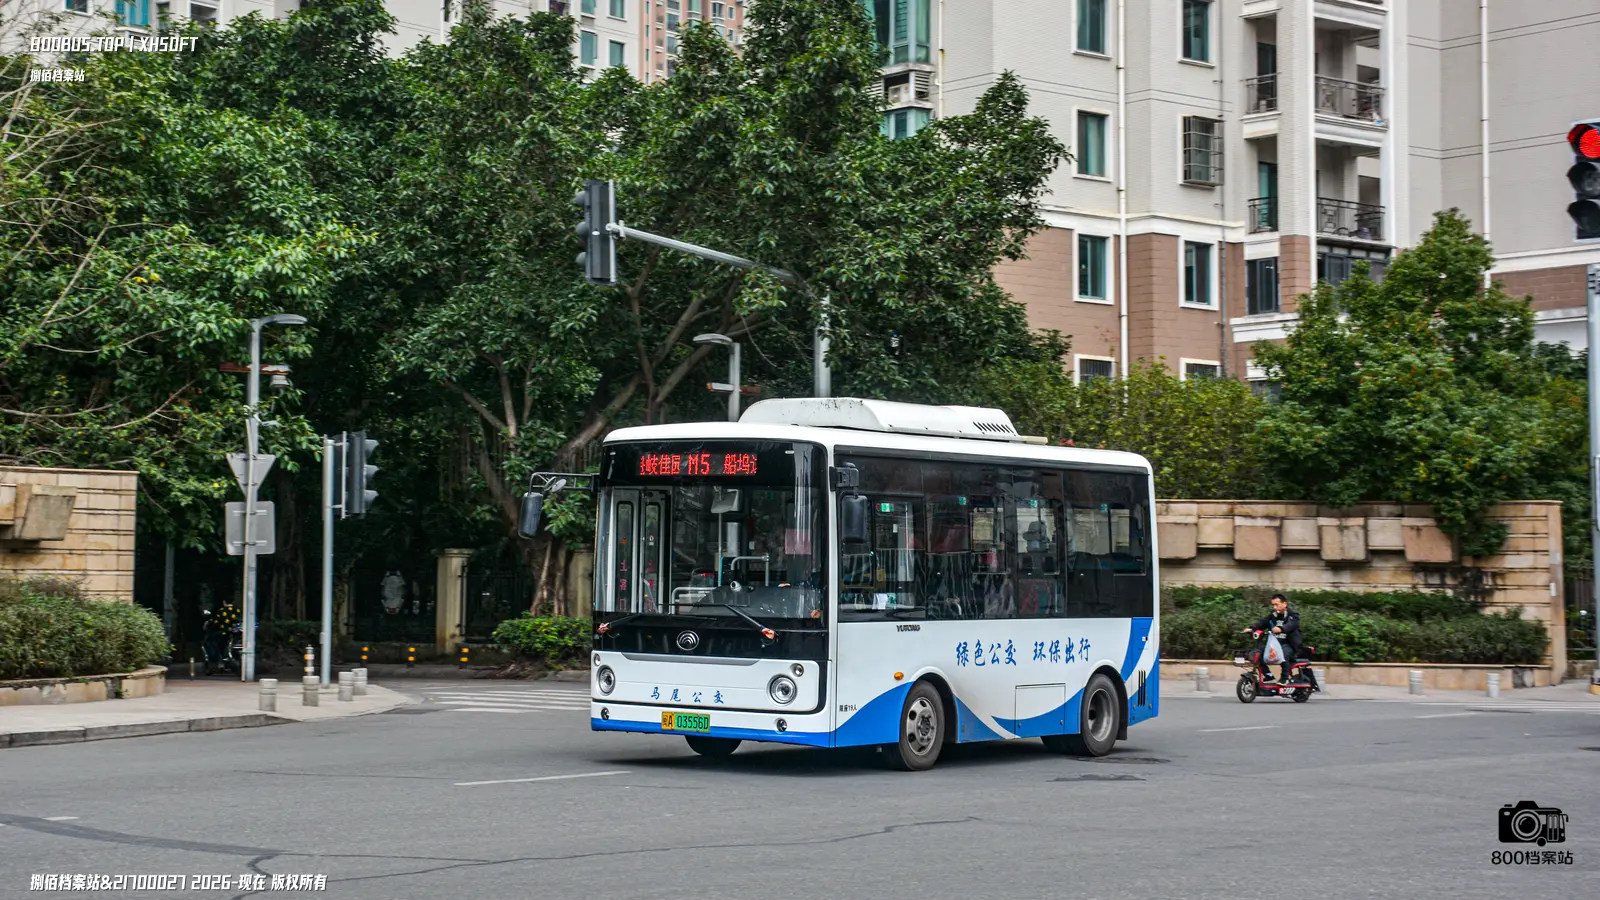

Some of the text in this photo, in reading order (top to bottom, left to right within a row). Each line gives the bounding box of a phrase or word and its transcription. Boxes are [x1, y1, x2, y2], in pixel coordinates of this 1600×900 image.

[687, 453, 711, 475] M5
[956, 637, 1091, 667] 绿色公交 环保出行
[650, 687, 724, 704] 马尾公交
[677, 715, 709, 729] 03556D
